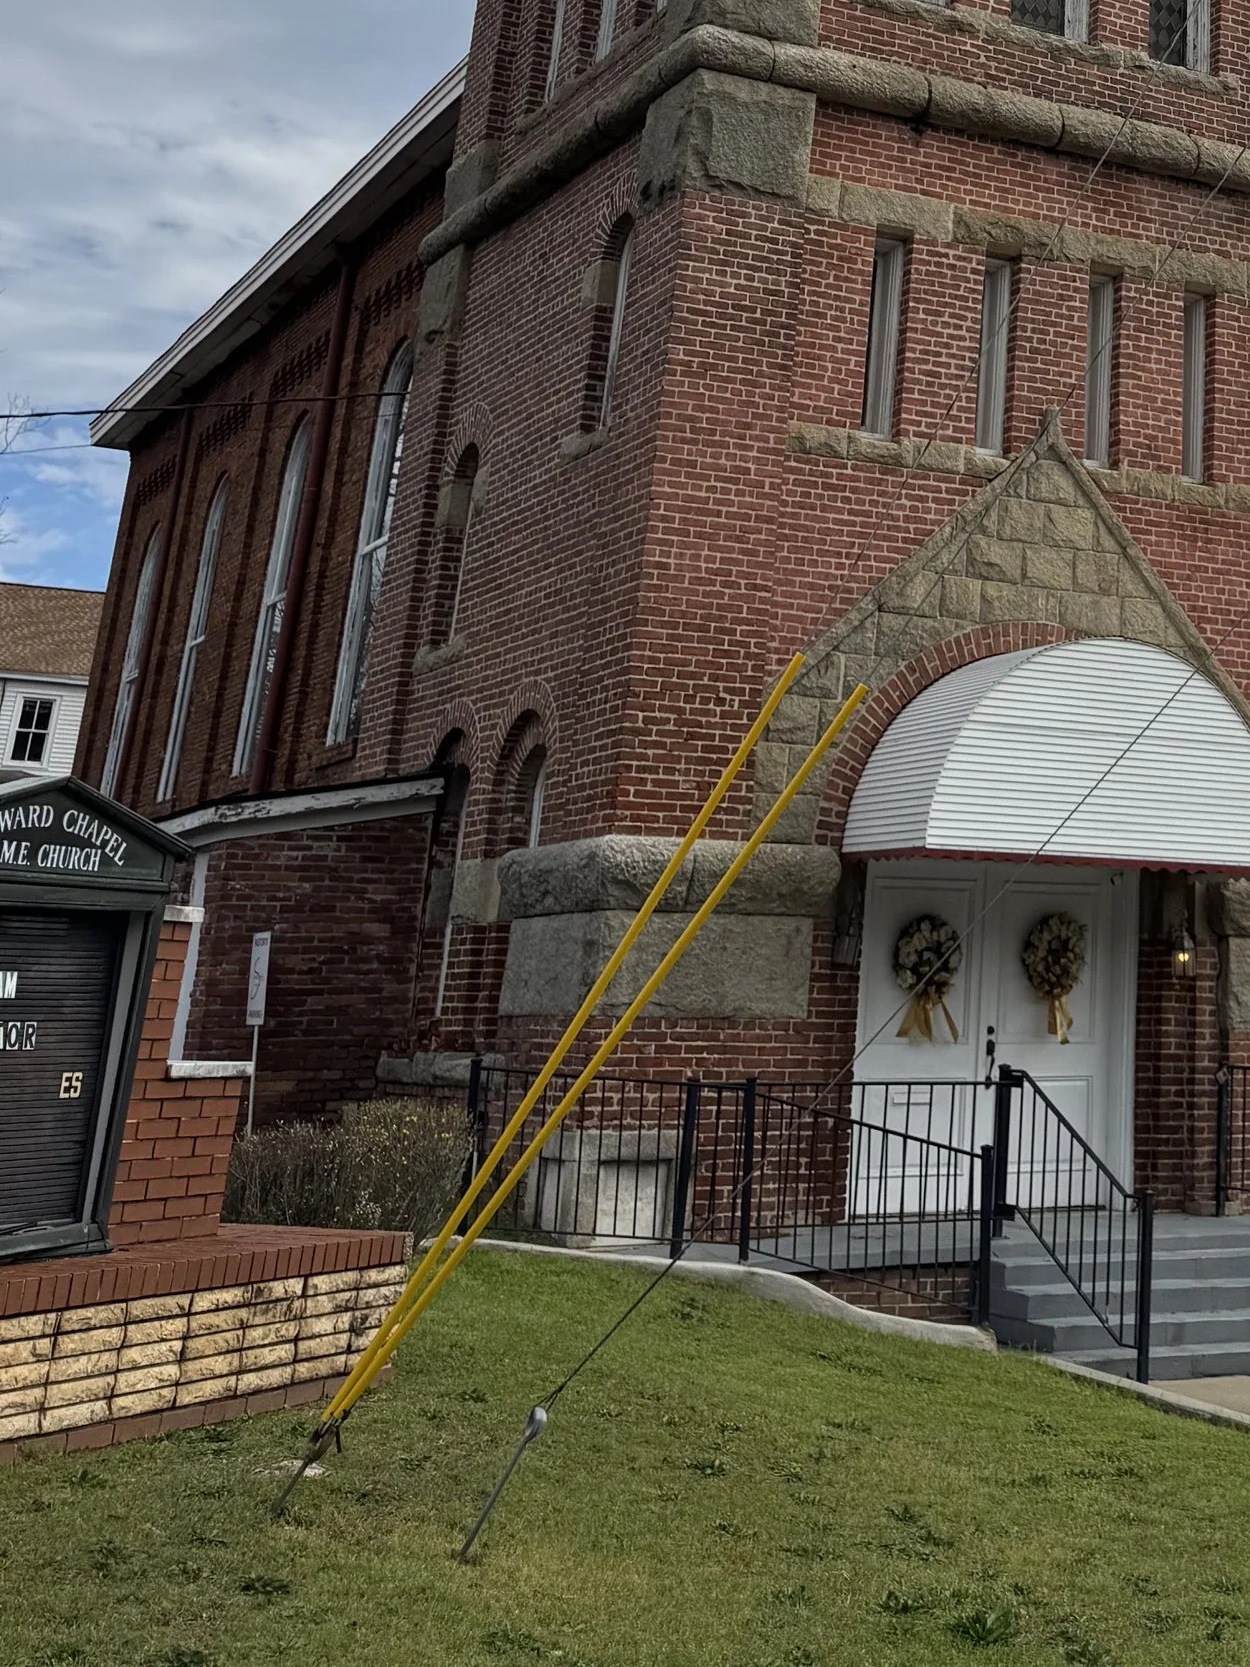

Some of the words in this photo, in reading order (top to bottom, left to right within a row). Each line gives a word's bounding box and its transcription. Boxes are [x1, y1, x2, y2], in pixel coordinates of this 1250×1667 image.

[0, 805, 54, 833] WARD
[62, 809, 127, 866] CHAPEL
[0, 840, 30, 866] M.E.
[37, 844, 102, 872] CHURCH
[59, 1072, 83, 1099] ES
